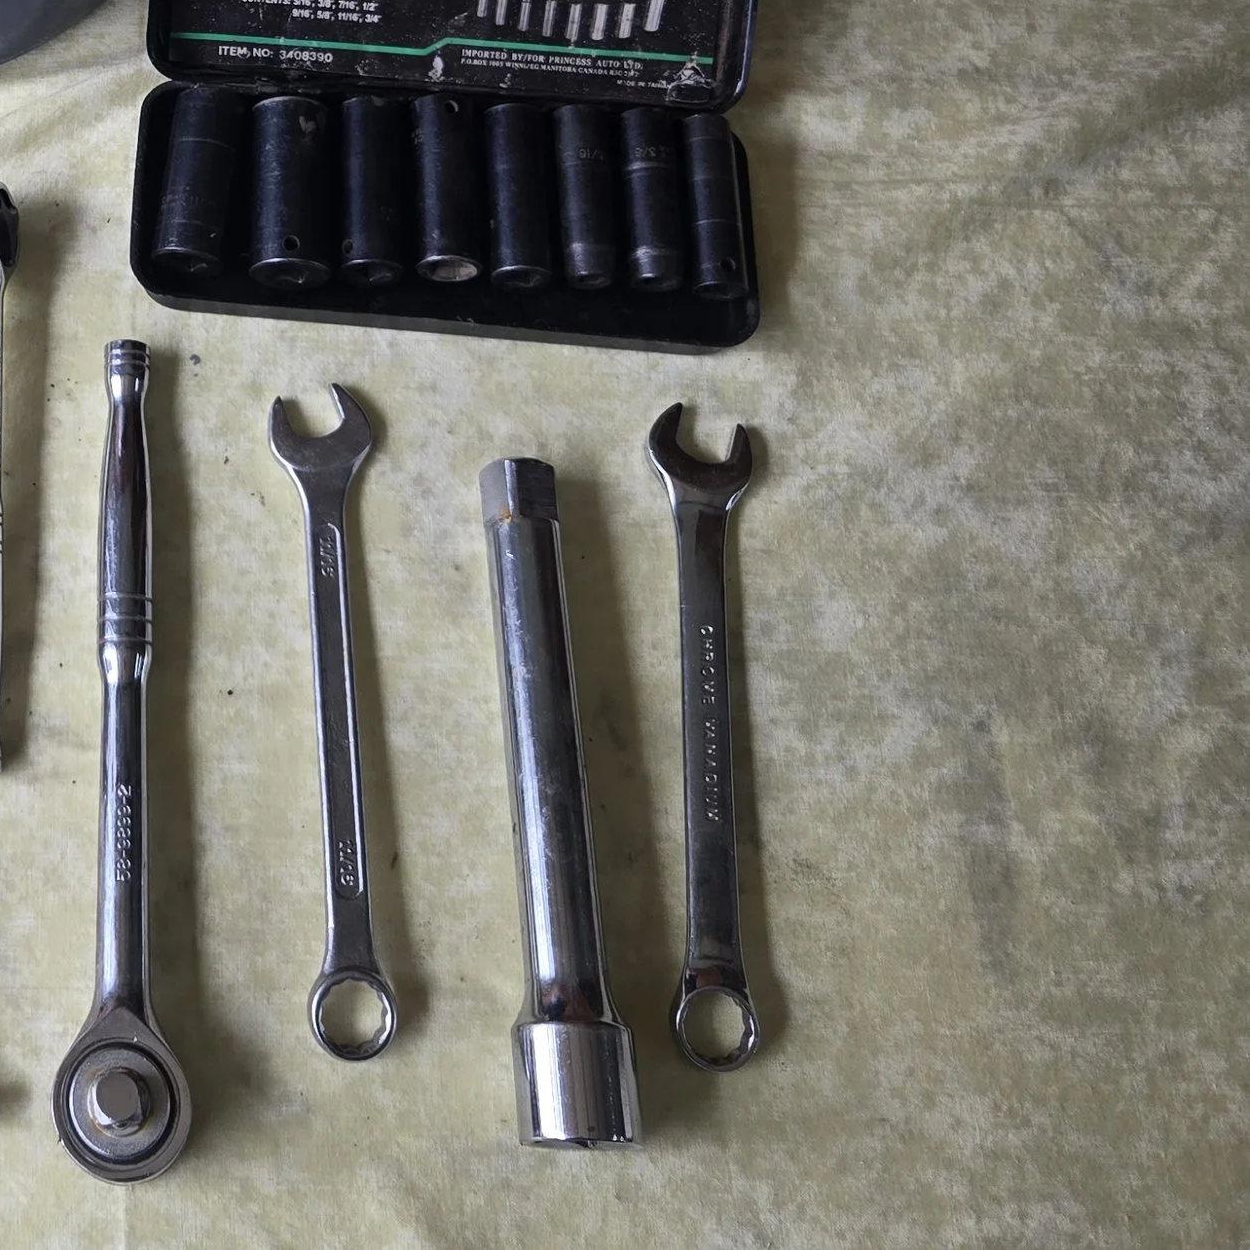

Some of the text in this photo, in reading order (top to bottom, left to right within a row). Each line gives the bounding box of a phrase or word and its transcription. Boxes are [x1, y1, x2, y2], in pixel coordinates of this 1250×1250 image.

[218, 45, 333, 63] ITEM NO: 3408390
[462, 49, 507, 60] IMPORTED
[511, 53, 545, 63] BY/FOR
[549, 55, 592, 67] PRINCESS
[596, 59, 620, 68] AUTO
[540, 63, 576, 73] MANITOBA
[578, 66, 608, 76] CANADA
